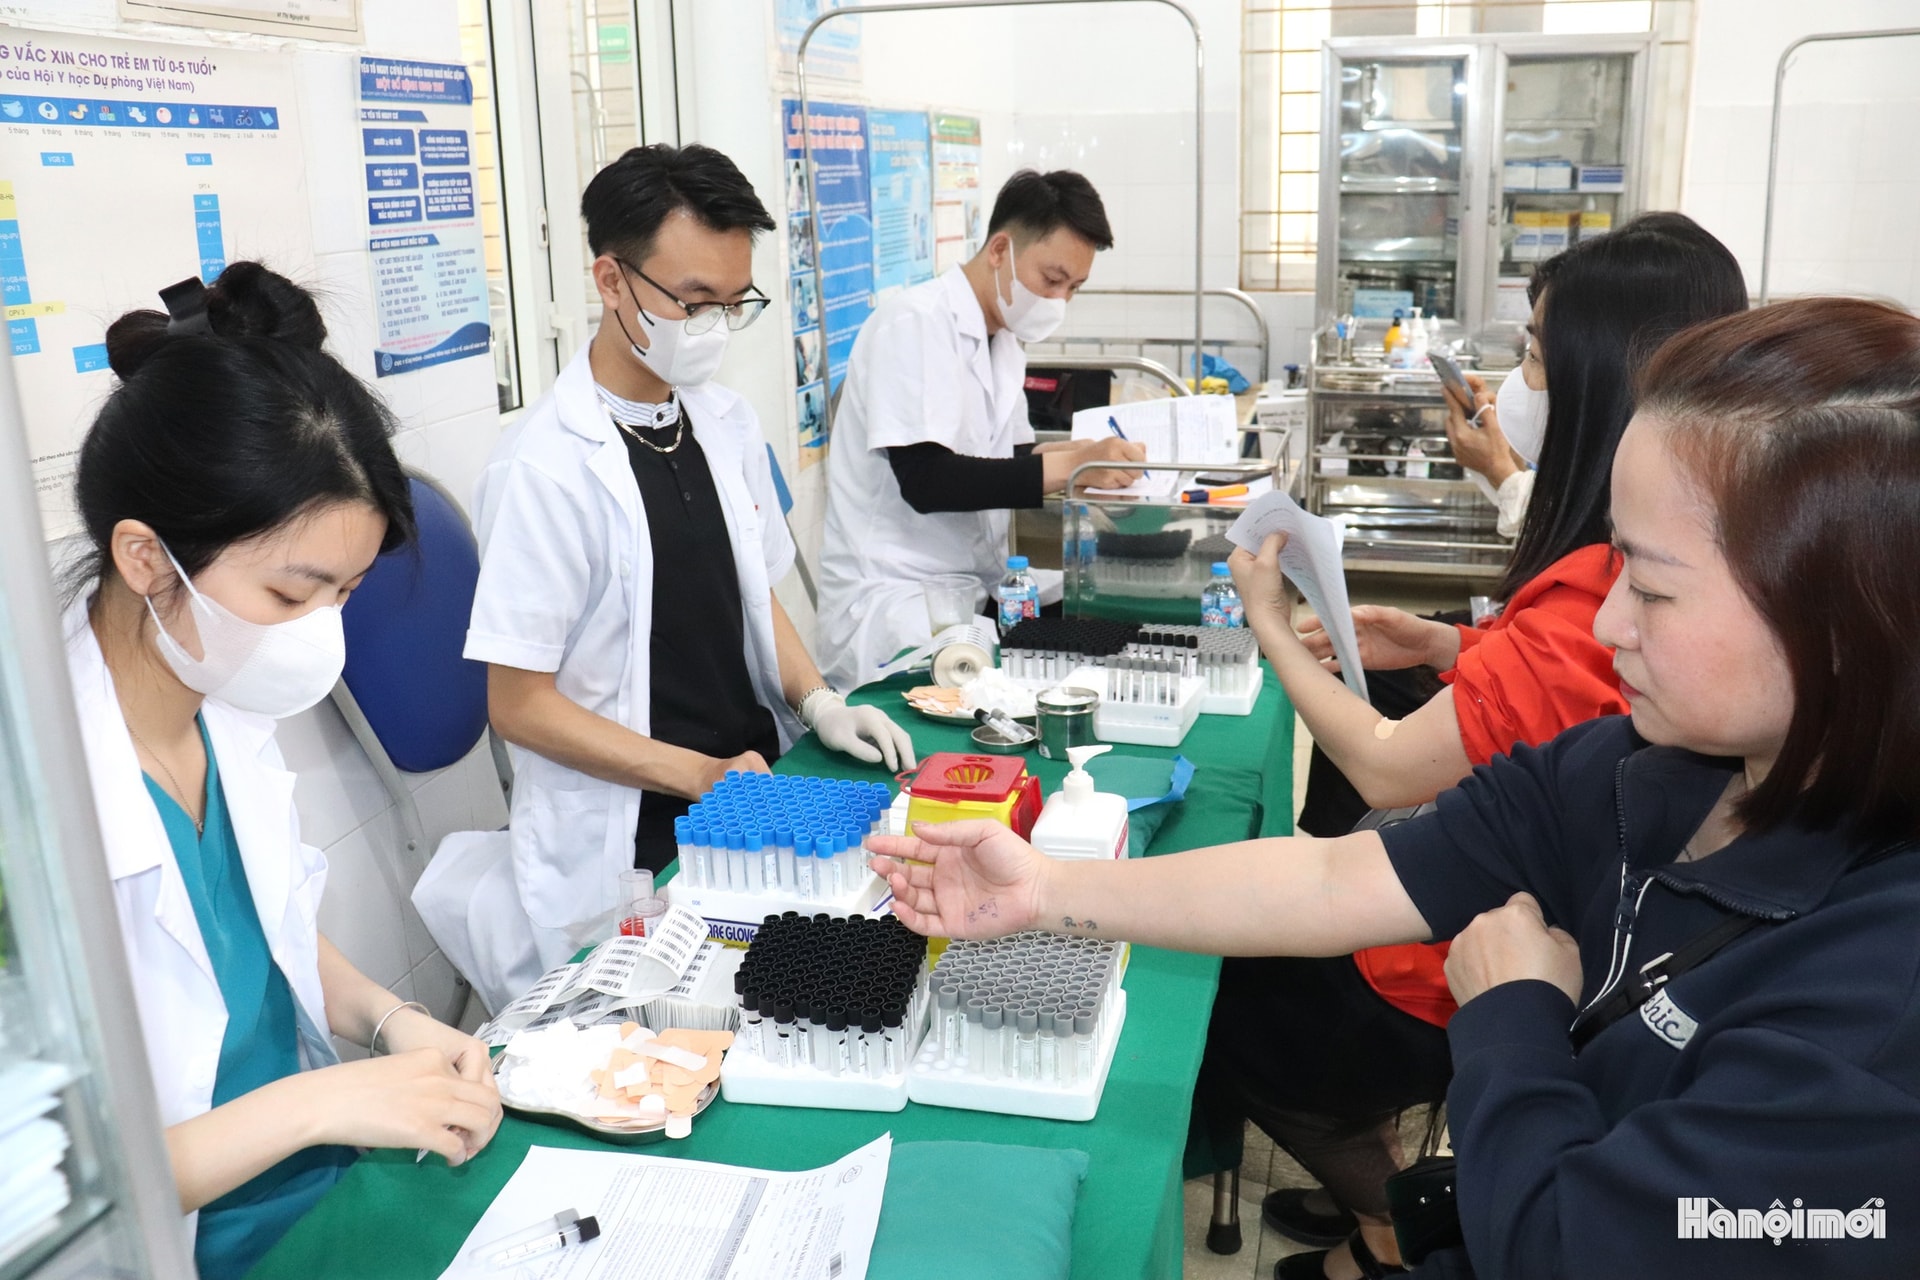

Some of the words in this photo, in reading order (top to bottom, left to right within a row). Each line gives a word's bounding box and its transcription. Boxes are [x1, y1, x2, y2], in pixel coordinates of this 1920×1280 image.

[14, 41, 47, 62] VẮC
[51, 49, 75, 65] XIN
[78, 52, 107, 67] CHO
[110, 52, 130, 69] TRẺ
[134, 57, 150, 71] EM
[152, 56, 166, 72] TỪ
[169, 60, 185, 73] 0-5
[7, 66, 30, 80] của
[34, 69, 54, 86] Hội
[57, 72, 65, 83] Y
[69, 72, 90, 88] học
[94, 74, 109, 89] Dự
[111, 76, 144, 91] phòng
[146, 77, 165, 92] Việt
[168, 79, 194, 93] Nam)
[1203, 613, 1228, 624] aVie
[707, 923, 724, 939] ARE
